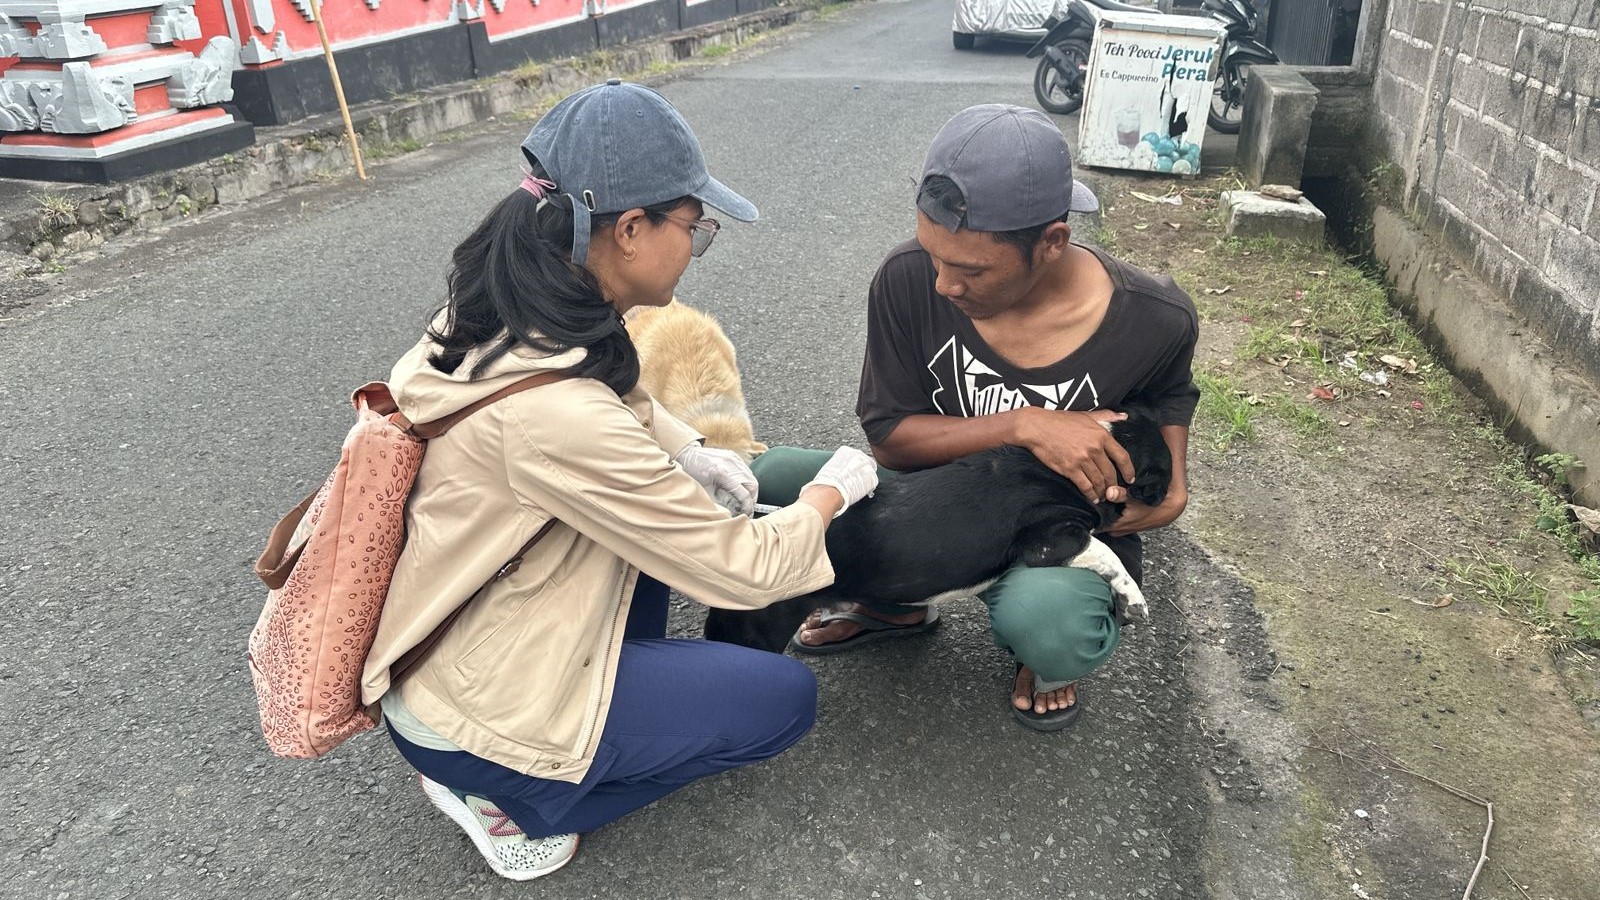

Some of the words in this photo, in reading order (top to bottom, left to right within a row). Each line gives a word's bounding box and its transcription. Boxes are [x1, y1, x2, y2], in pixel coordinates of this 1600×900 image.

[1104, 42, 1125, 56] Teh
[1100, 69, 1110, 78] Es
[1111, 70, 1159, 82] Cappuccino
[1161, 63, 1207, 81] Pera
